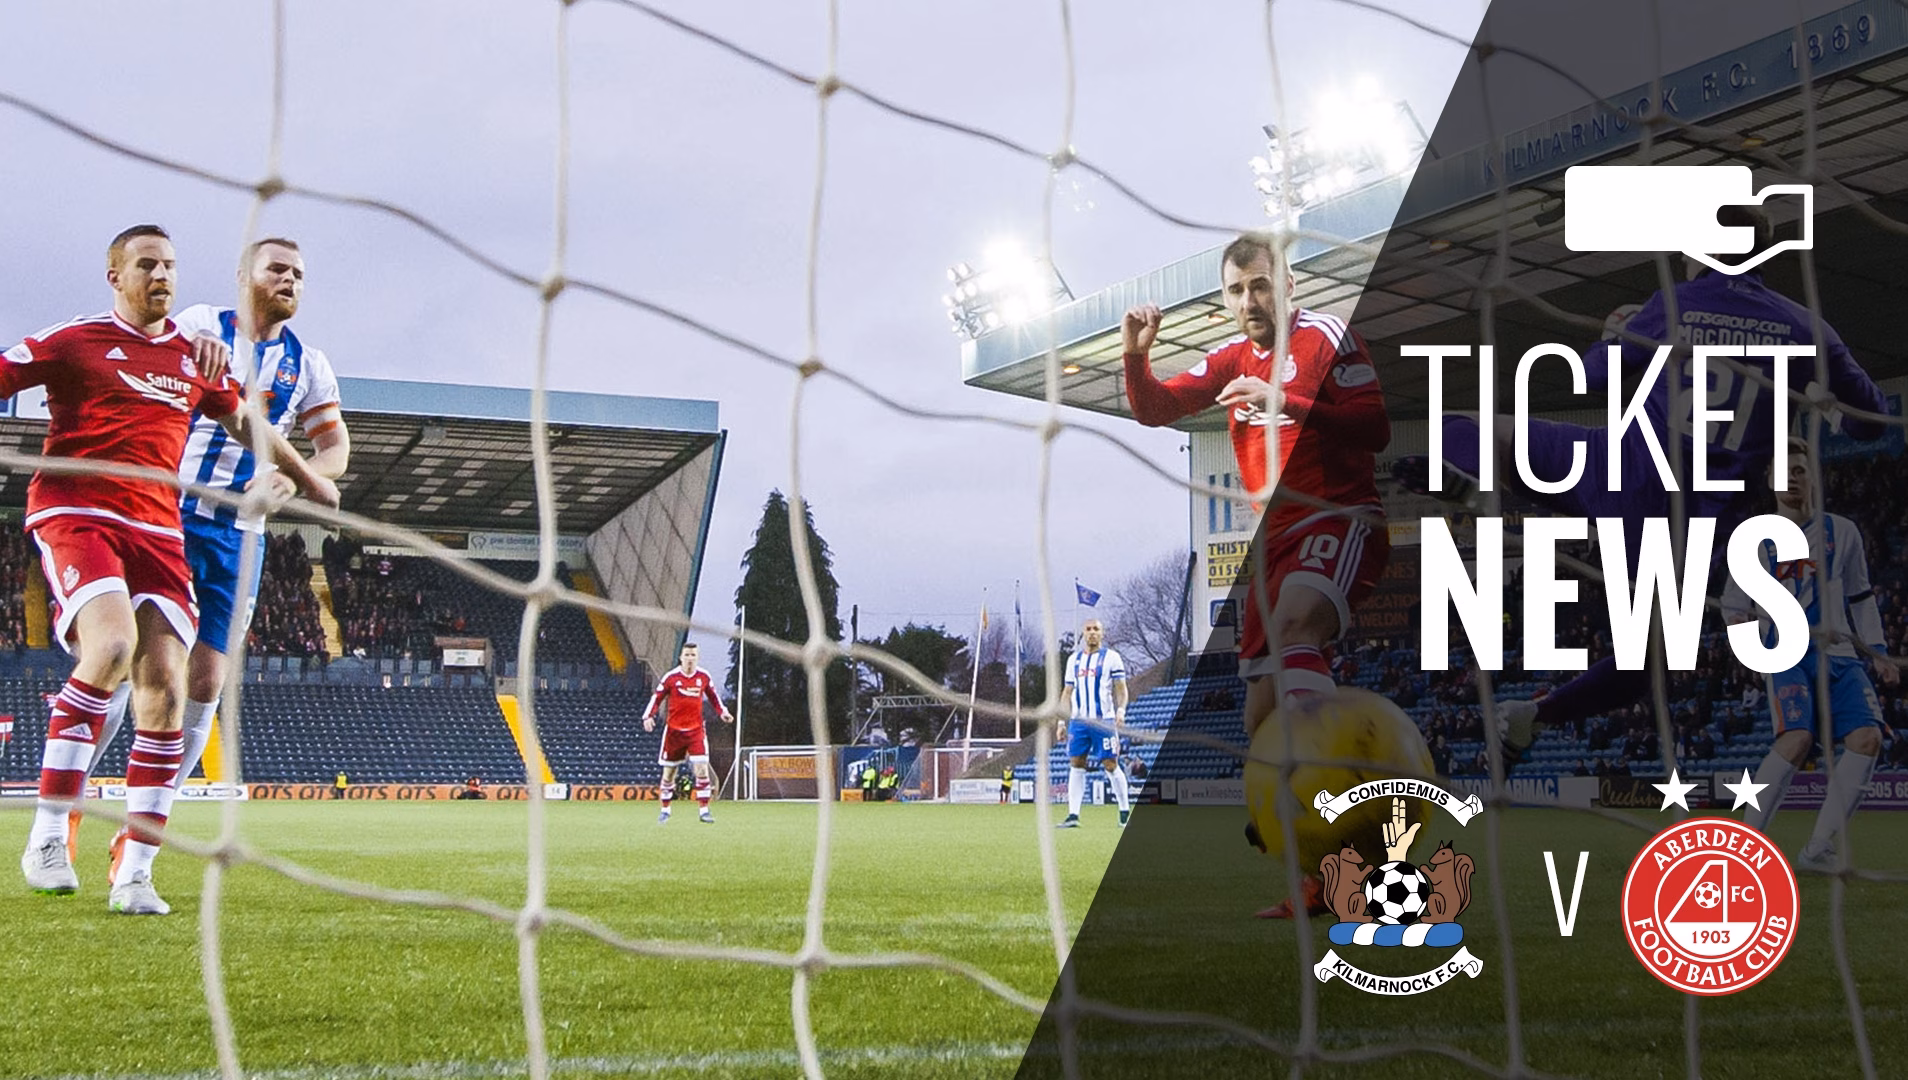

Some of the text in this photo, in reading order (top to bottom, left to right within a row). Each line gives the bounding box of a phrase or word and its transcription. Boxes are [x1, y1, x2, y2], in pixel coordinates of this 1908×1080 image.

[1787, 13, 1876, 69] 1869
[146, 372, 192, 395] Saltire
[1208, 541, 1254, 555] THISTL
[1298, 534, 1340, 559] 10
